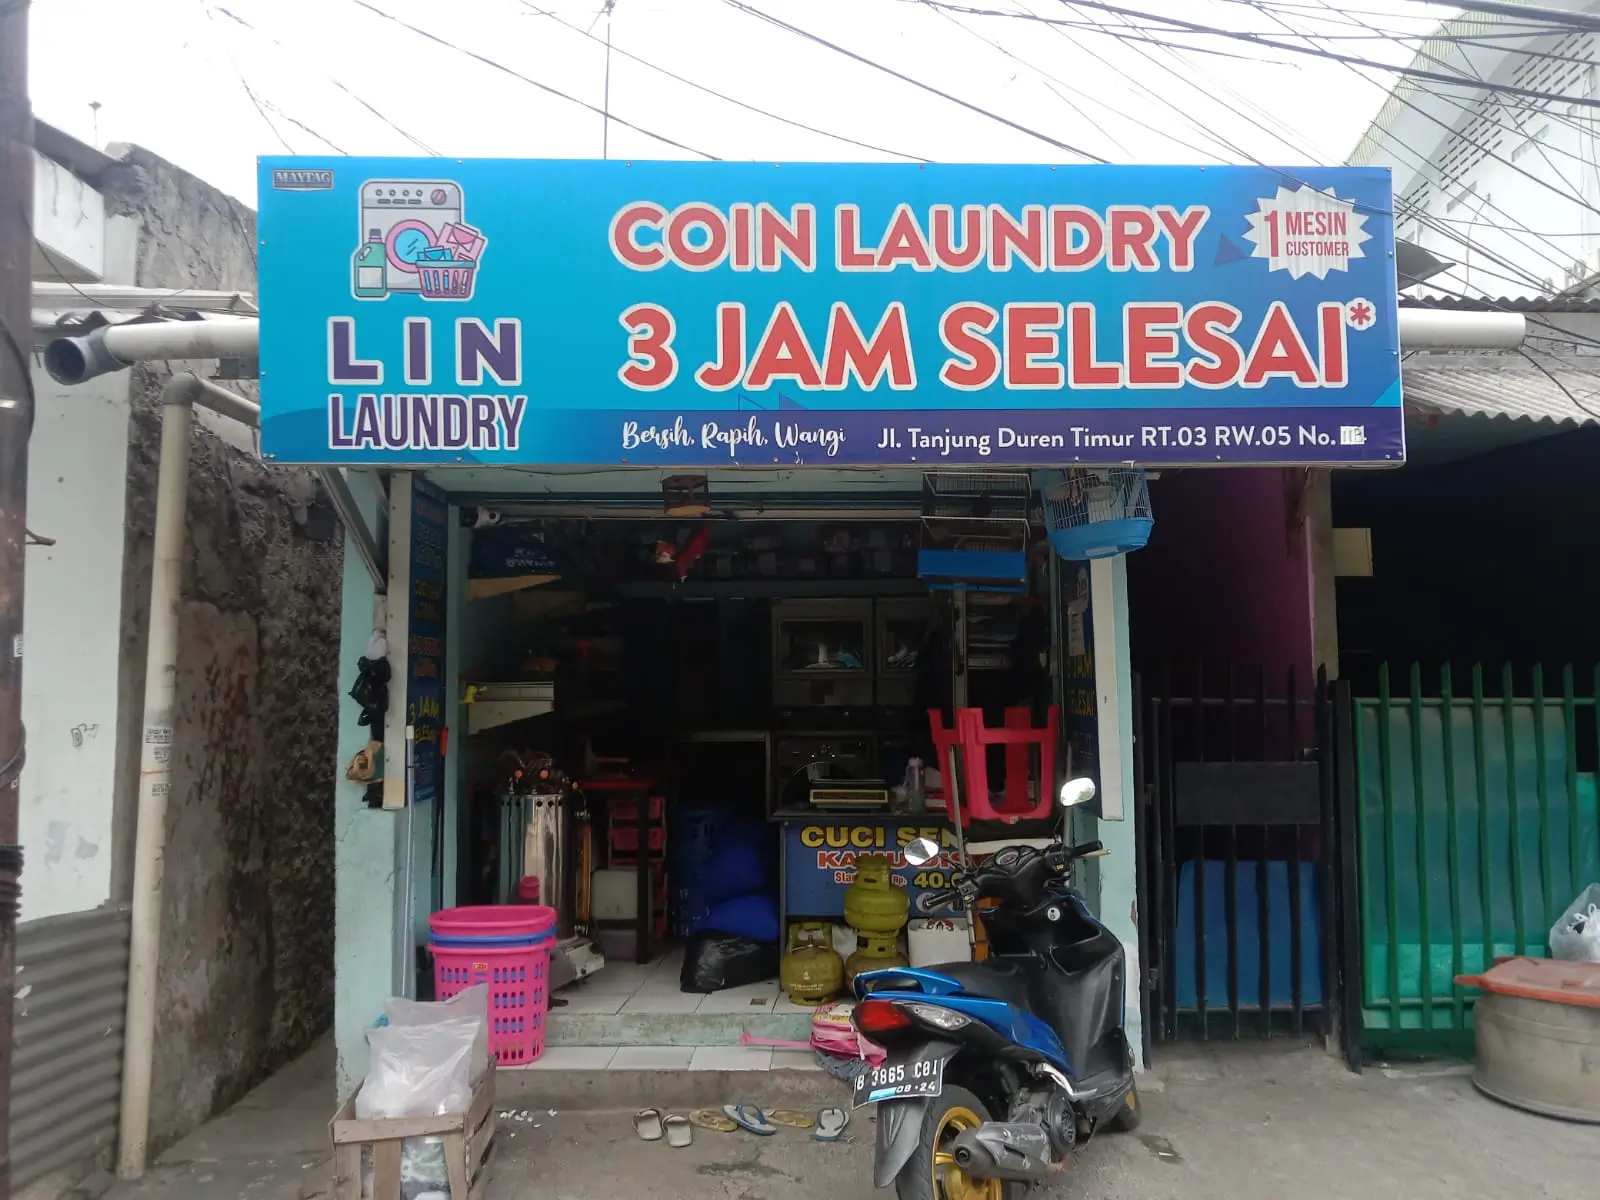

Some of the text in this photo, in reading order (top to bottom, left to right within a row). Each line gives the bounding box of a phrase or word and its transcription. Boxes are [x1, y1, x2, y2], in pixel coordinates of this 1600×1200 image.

[275, 172, 331, 184] MAYTAG
[608, 202, 1211, 273] COIN LAUNDRY
[1264, 210, 1347, 257] 1 MESIN
[1286, 241, 1349, 256] CUSTOMER
[326, 316, 523, 387] LIN
[618, 302, 679, 390] 3
[694, 301, 918, 392] JAM
[327, 393, 528, 451] LAUNDRY
[622, 415, 847, 457] Bersih, Rapih, Wangi
[877, 427, 902, 449] Jl.
[907, 427, 991, 456] Tanjung
[998, 427, 1064, 448] Duren
[1070, 426, 1134, 448] Timur
[1141, 426, 1207, 447] RT.03
[1215, 425, 1291, 446] RW.05
[418, 696, 441, 720] JAM
[800, 825, 885, 848] CUCI
[857, 1074, 865, 1090] B
[871, 1065, 905, 1087] 3865
